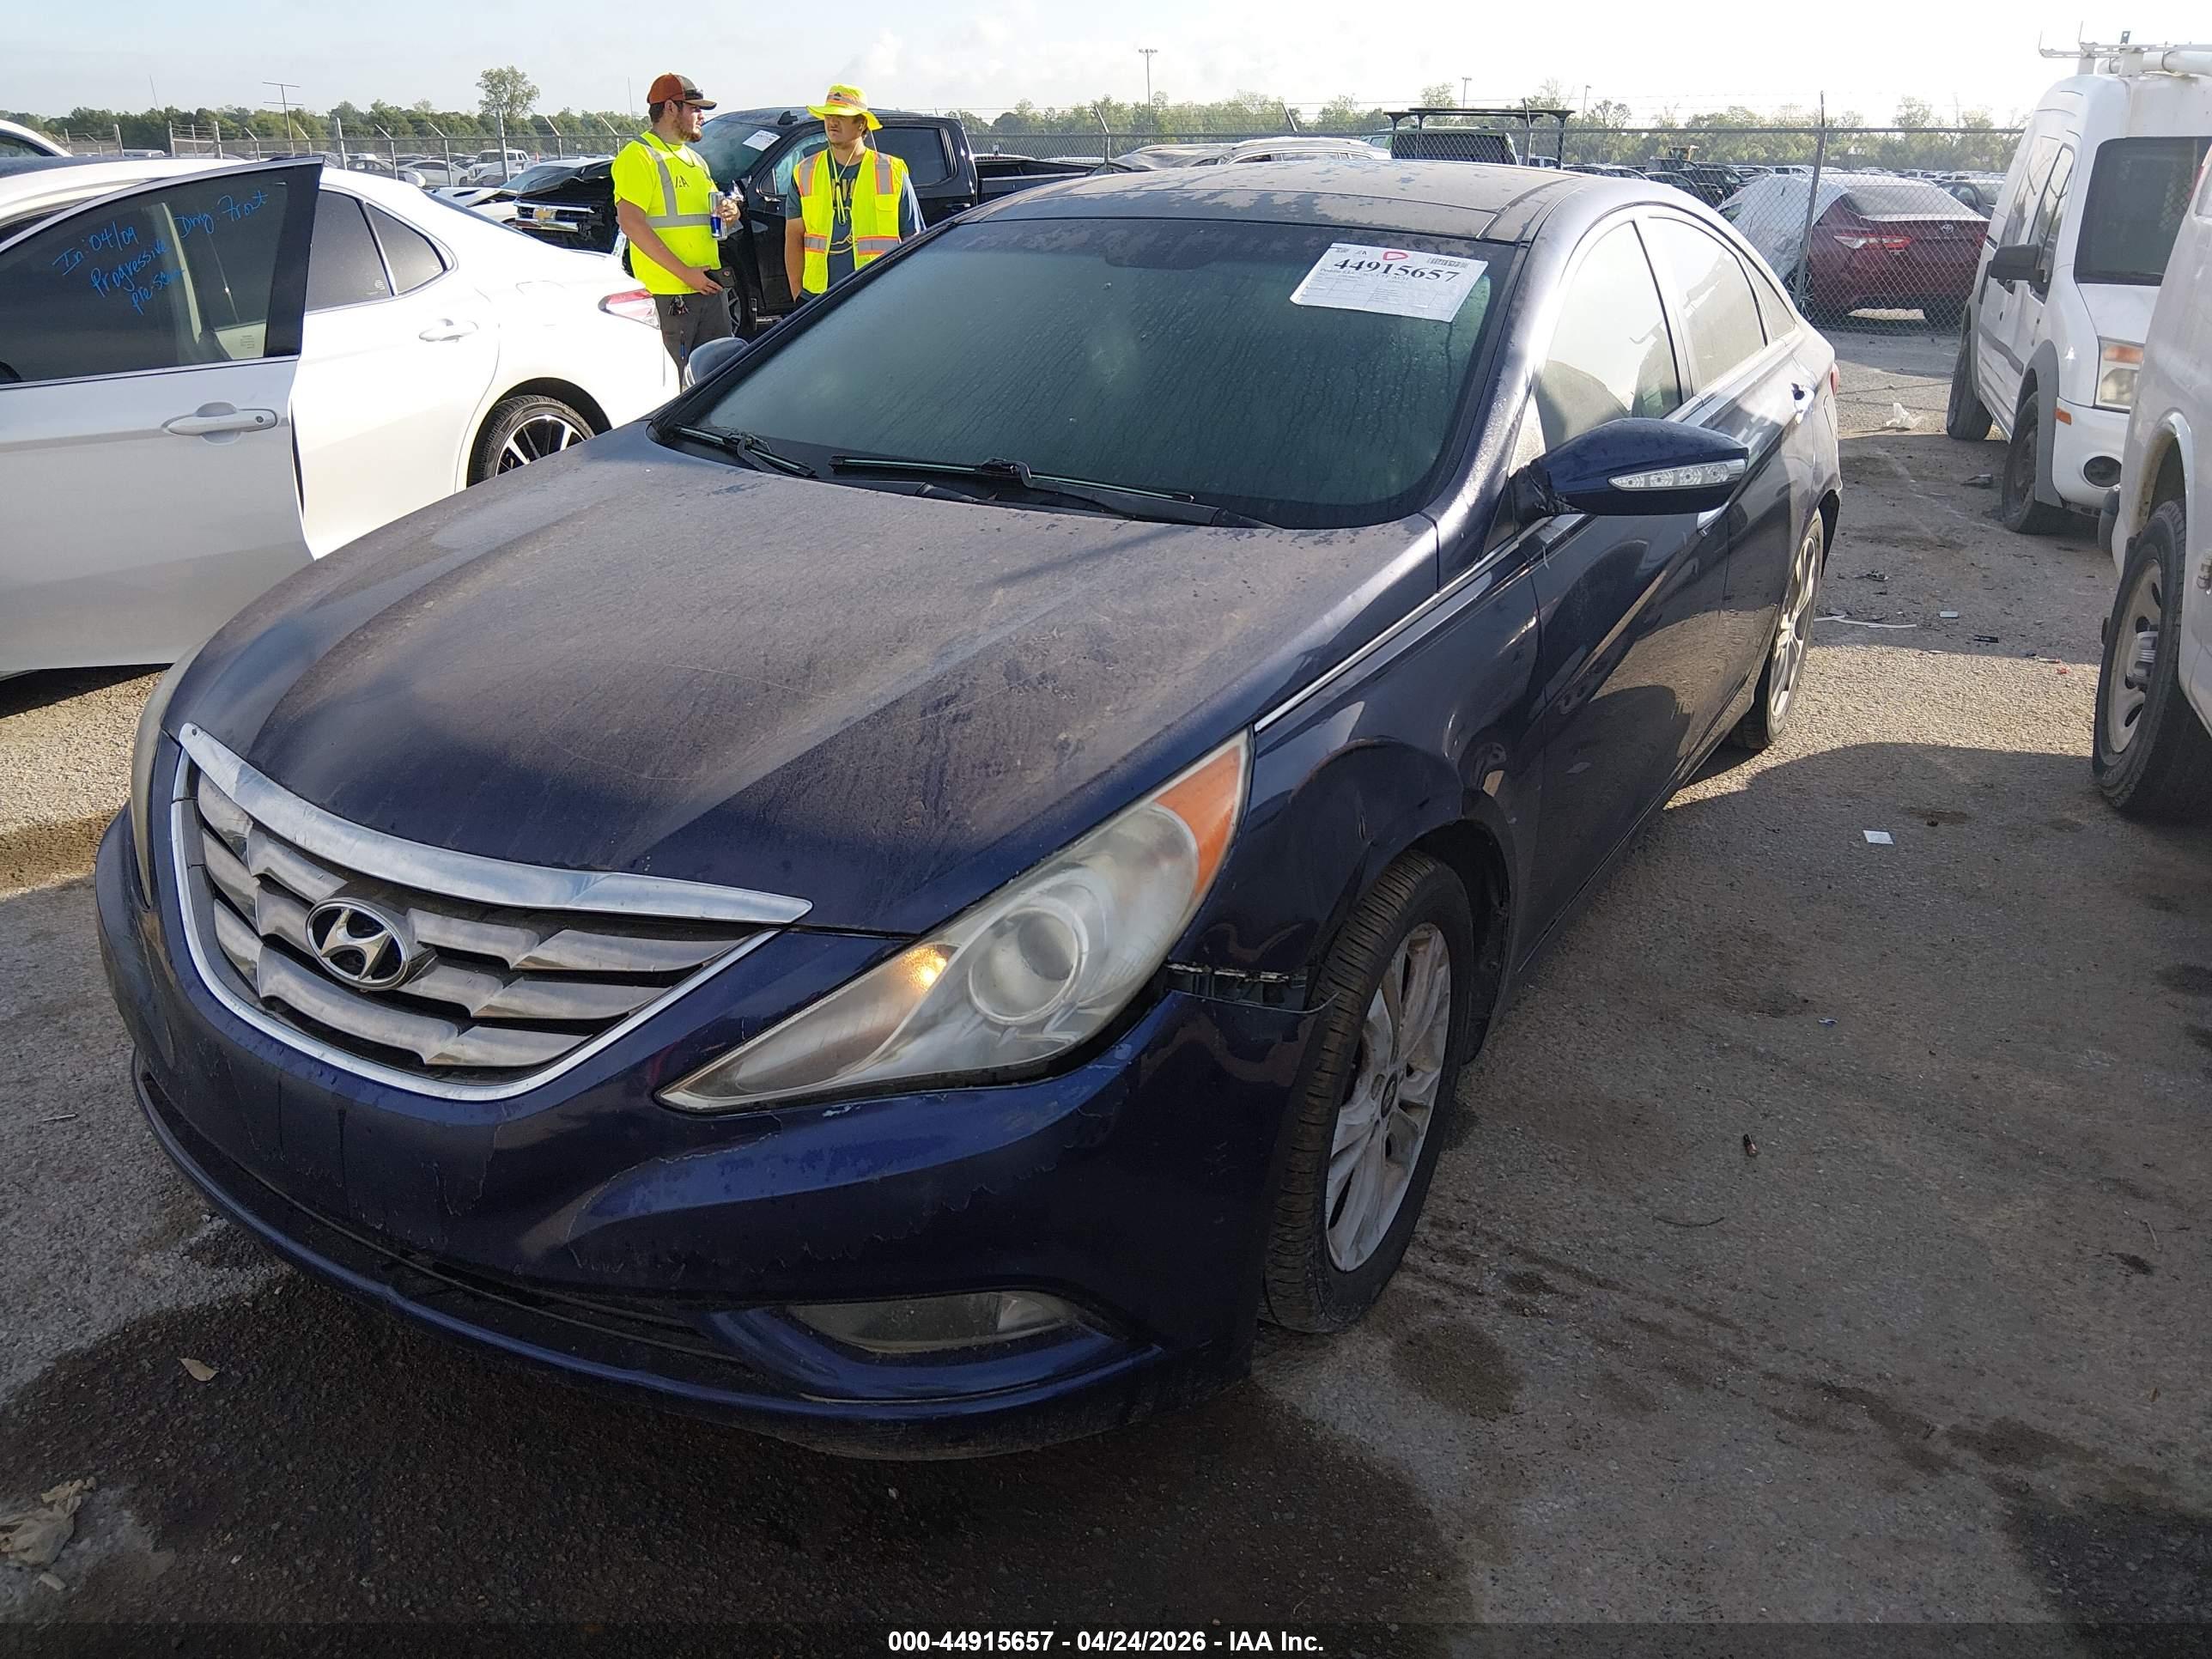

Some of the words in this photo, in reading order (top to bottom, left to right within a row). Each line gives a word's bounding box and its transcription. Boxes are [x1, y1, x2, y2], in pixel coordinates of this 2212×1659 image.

[217, 190, 269, 222] Front
[88, 221, 139, 252] 04/09
[90, 238, 171, 299] Progressive
[1334, 258, 1462, 283] 44915657
